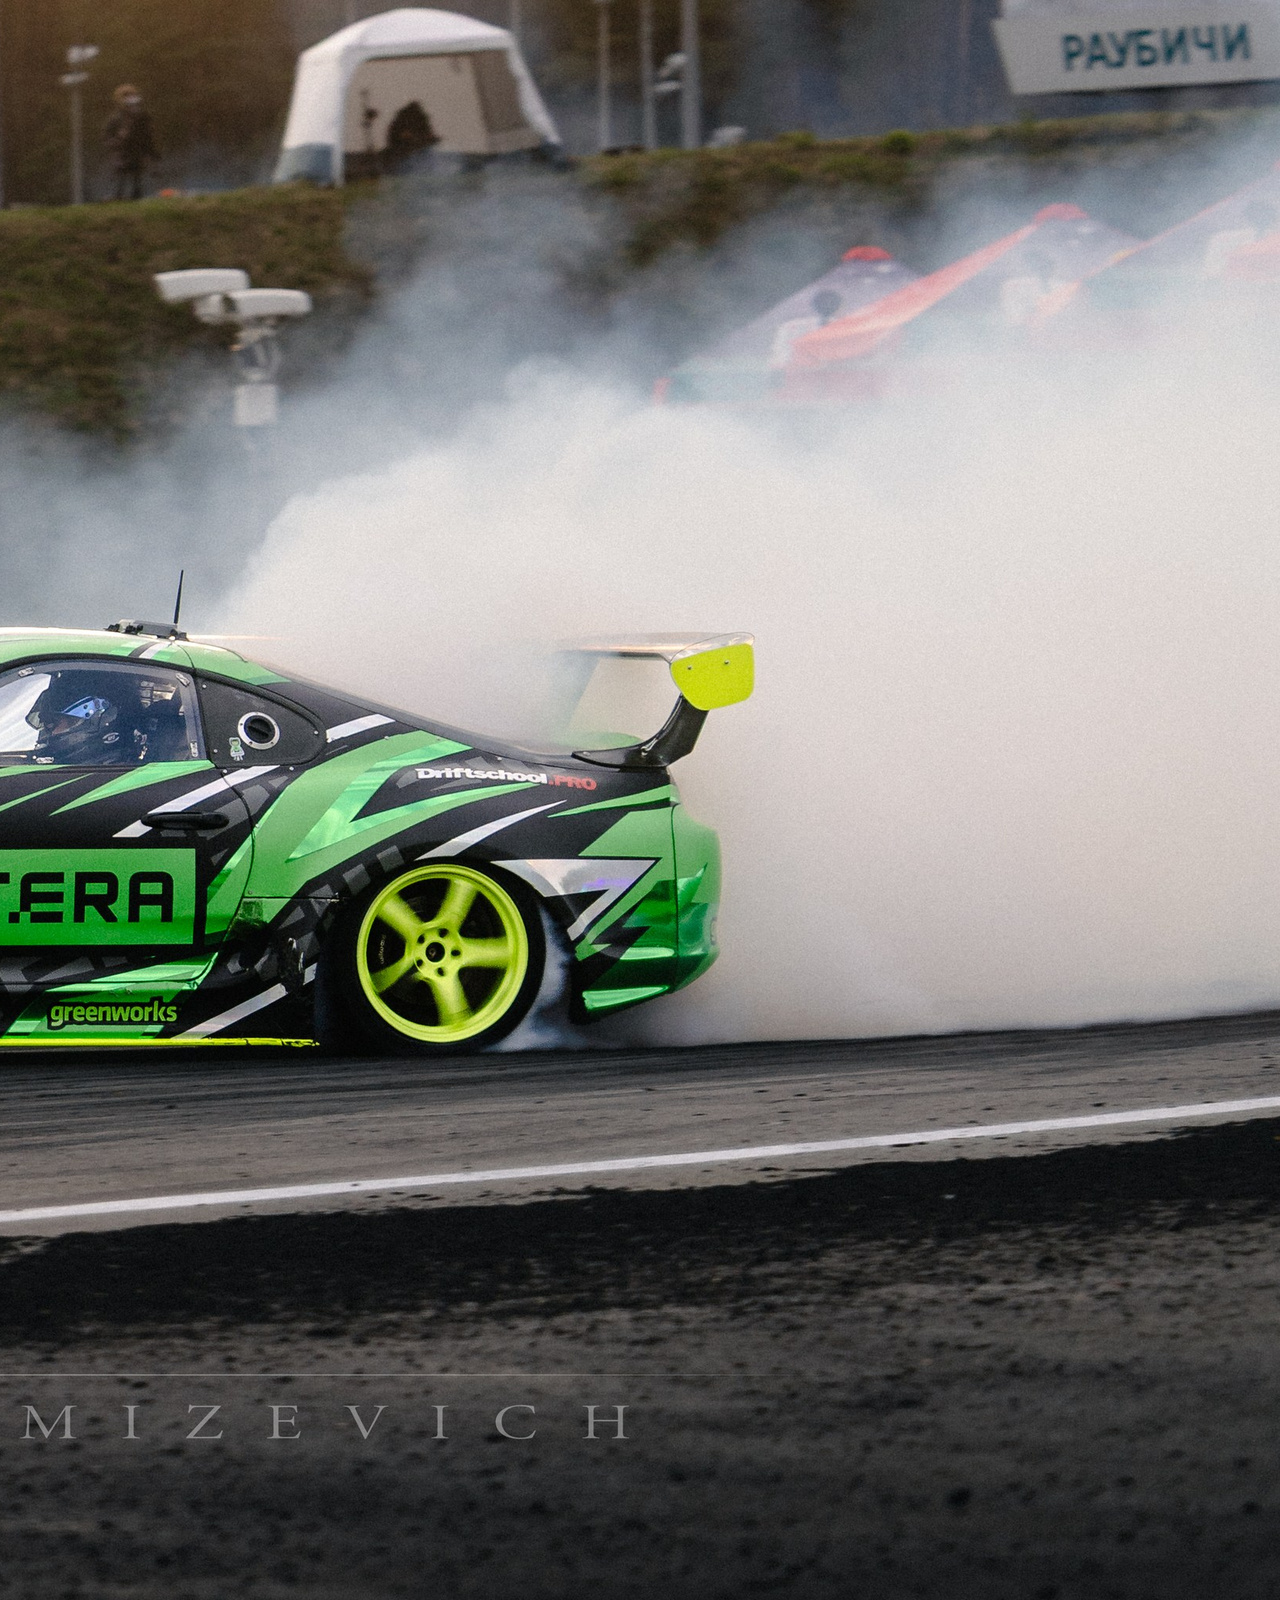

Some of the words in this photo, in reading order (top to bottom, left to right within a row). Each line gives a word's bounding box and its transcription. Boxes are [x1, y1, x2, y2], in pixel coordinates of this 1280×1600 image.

[1061, 22, 1251, 71] РАУБИЧИ
[415, 767, 597, 791] Driftschool.PRO
[50, 1000, 178, 1027] greenworks
